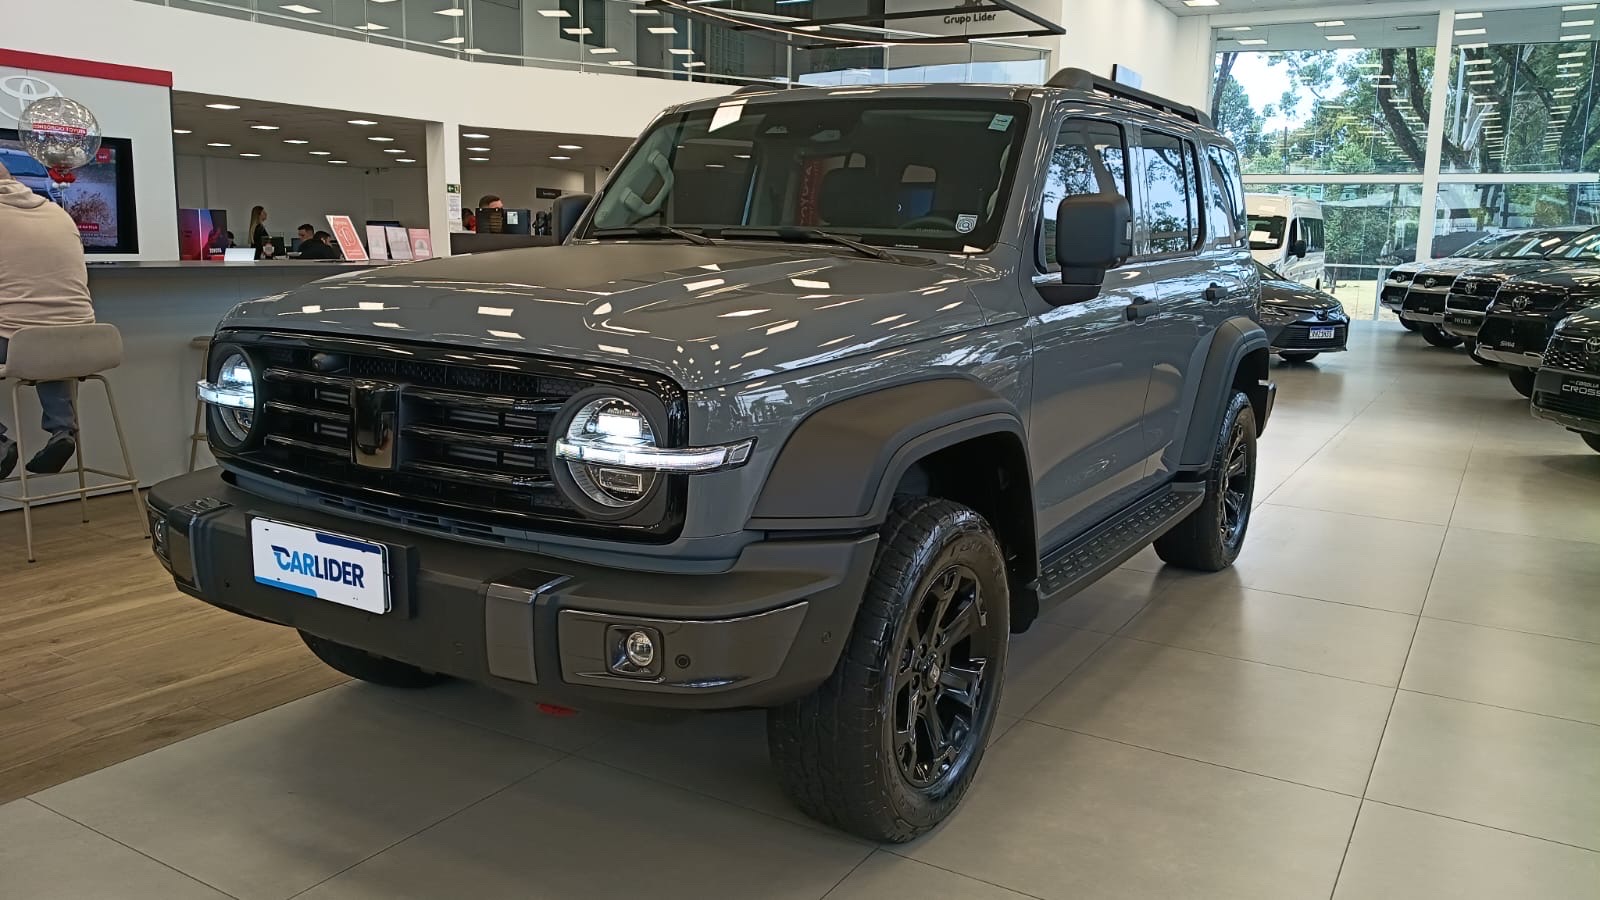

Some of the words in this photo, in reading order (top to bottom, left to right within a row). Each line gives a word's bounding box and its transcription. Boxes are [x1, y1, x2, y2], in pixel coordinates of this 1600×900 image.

[943, 15, 971, 24] Grupo
[974, 13, 996, 22] Lider
[271, 545, 364, 588] CARLIDER
